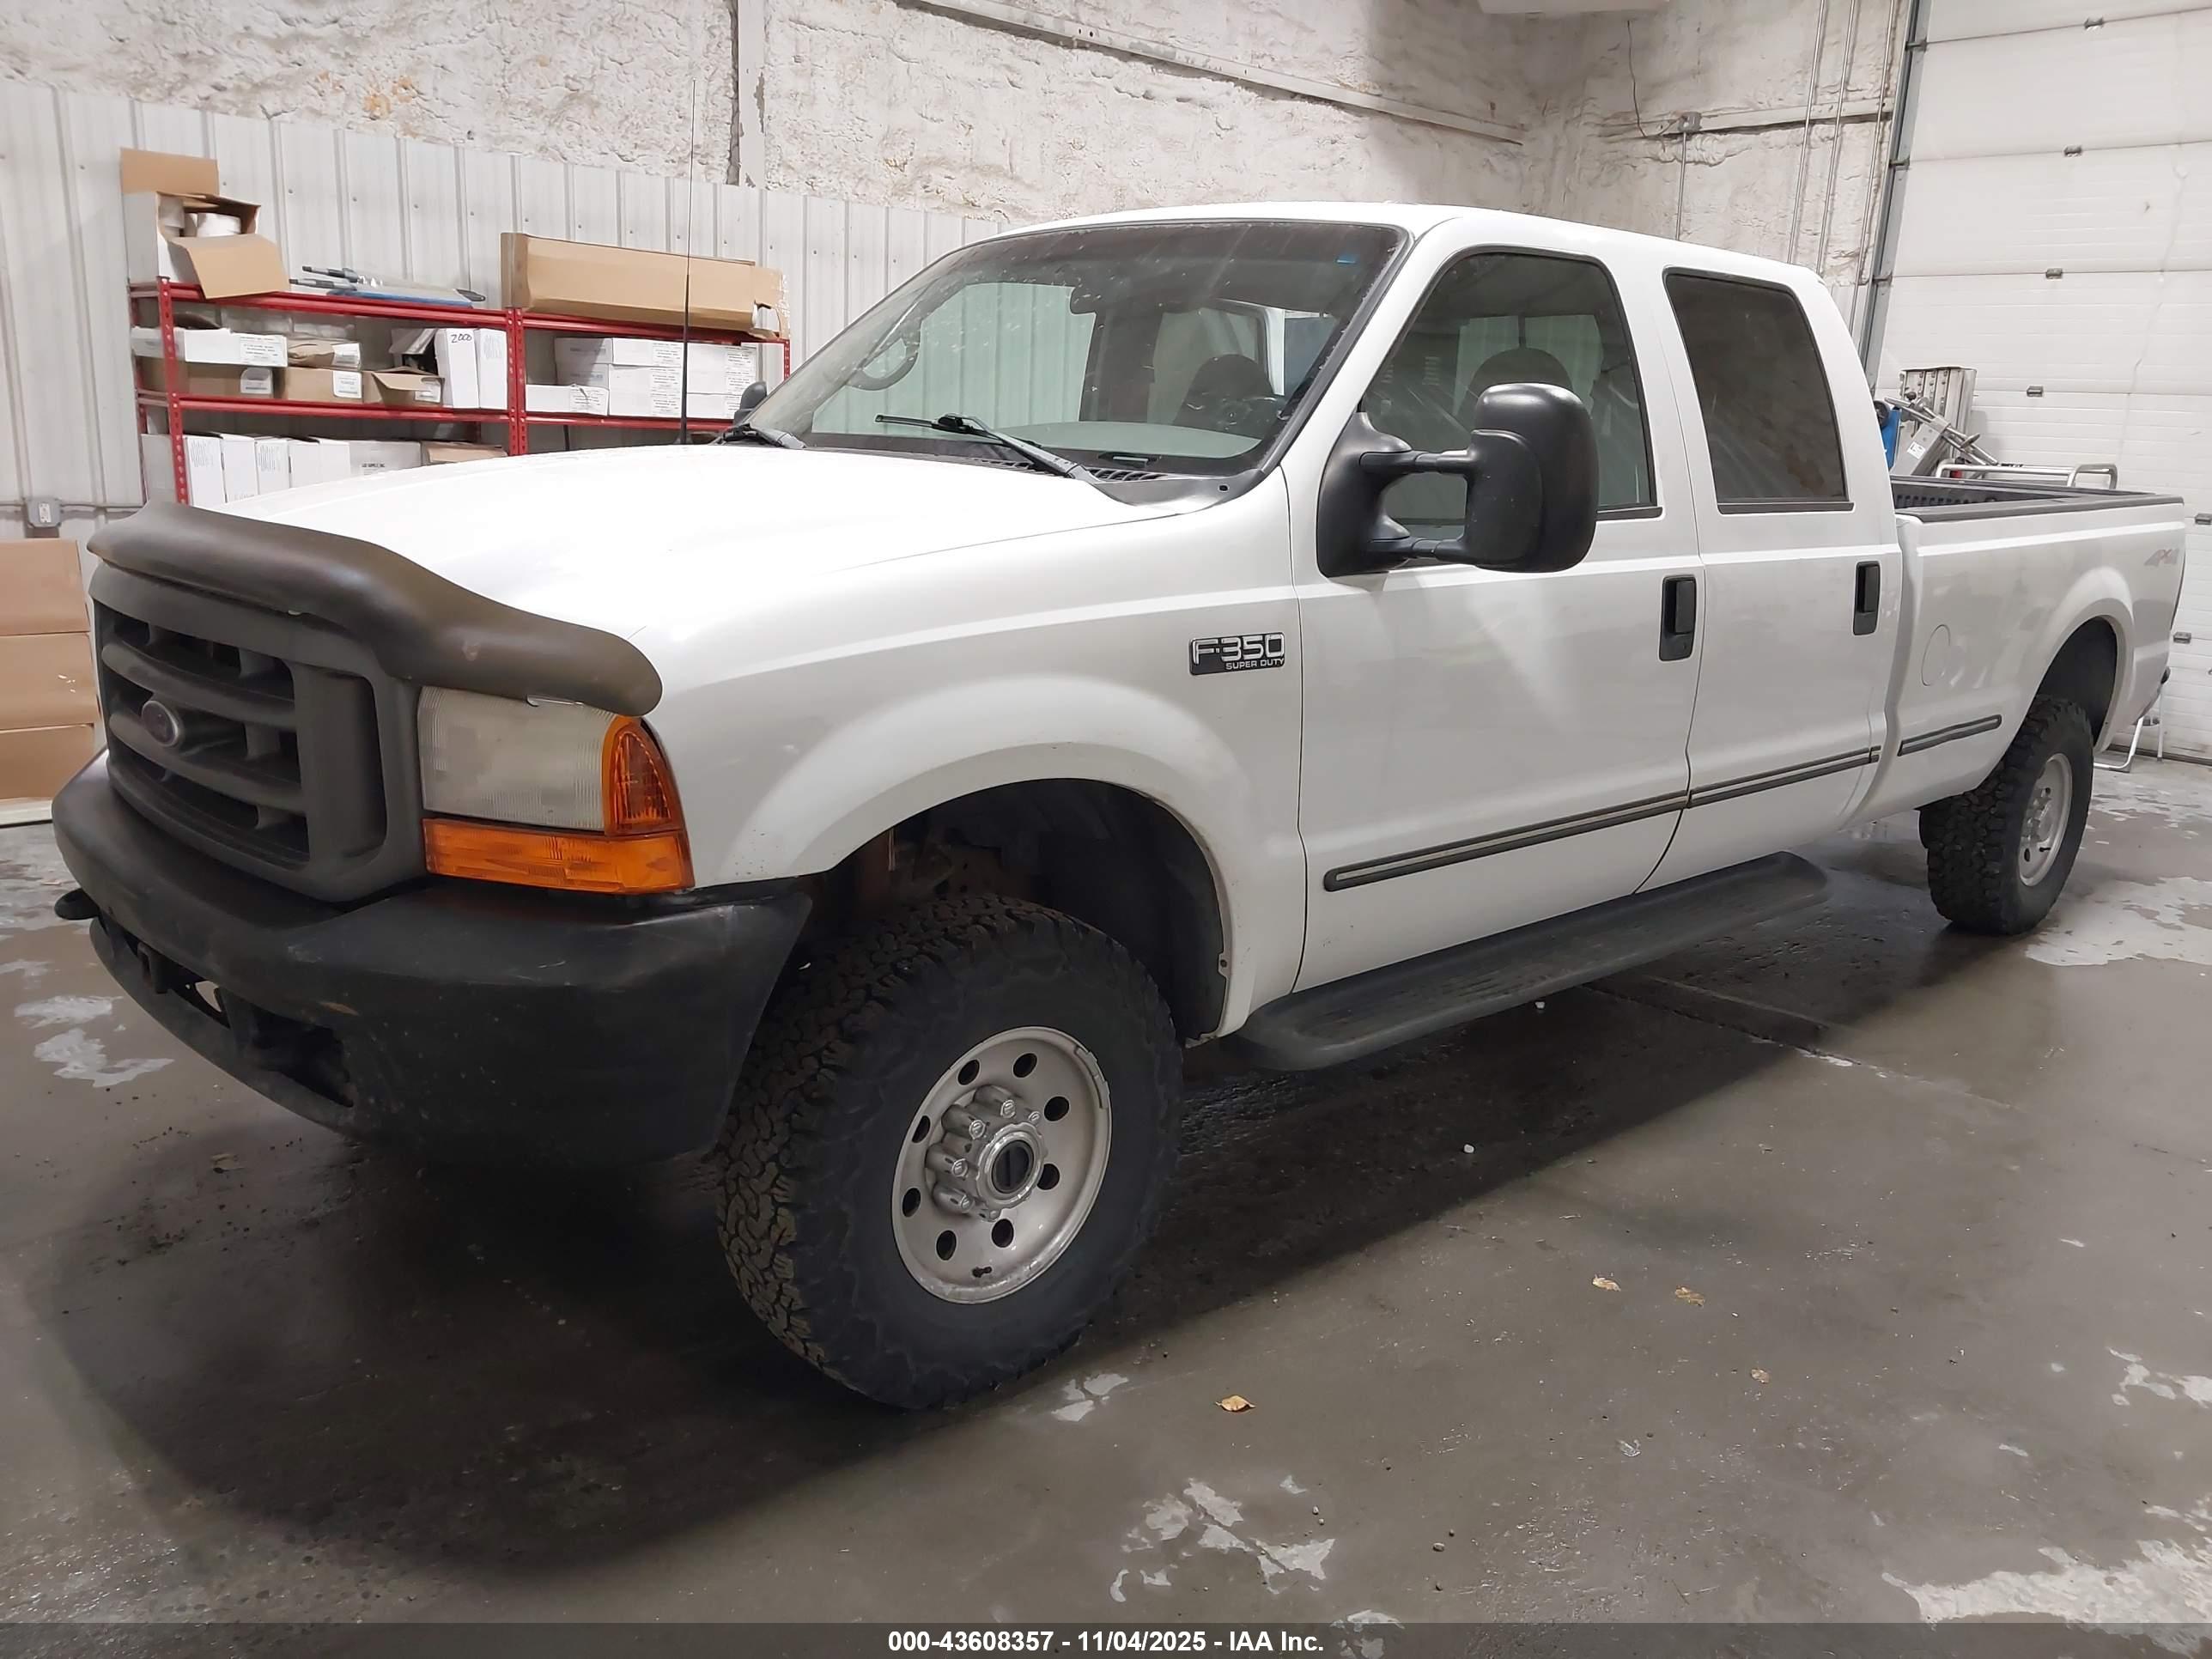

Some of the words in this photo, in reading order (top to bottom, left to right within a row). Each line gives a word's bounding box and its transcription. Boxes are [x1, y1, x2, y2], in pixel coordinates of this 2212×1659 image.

[451, 333, 472, 343] 2000
[1192, 634, 1285, 665] F-350
[1225, 660, 1258, 671] SUPER
[1260, 658, 1285, 667] DUTY
